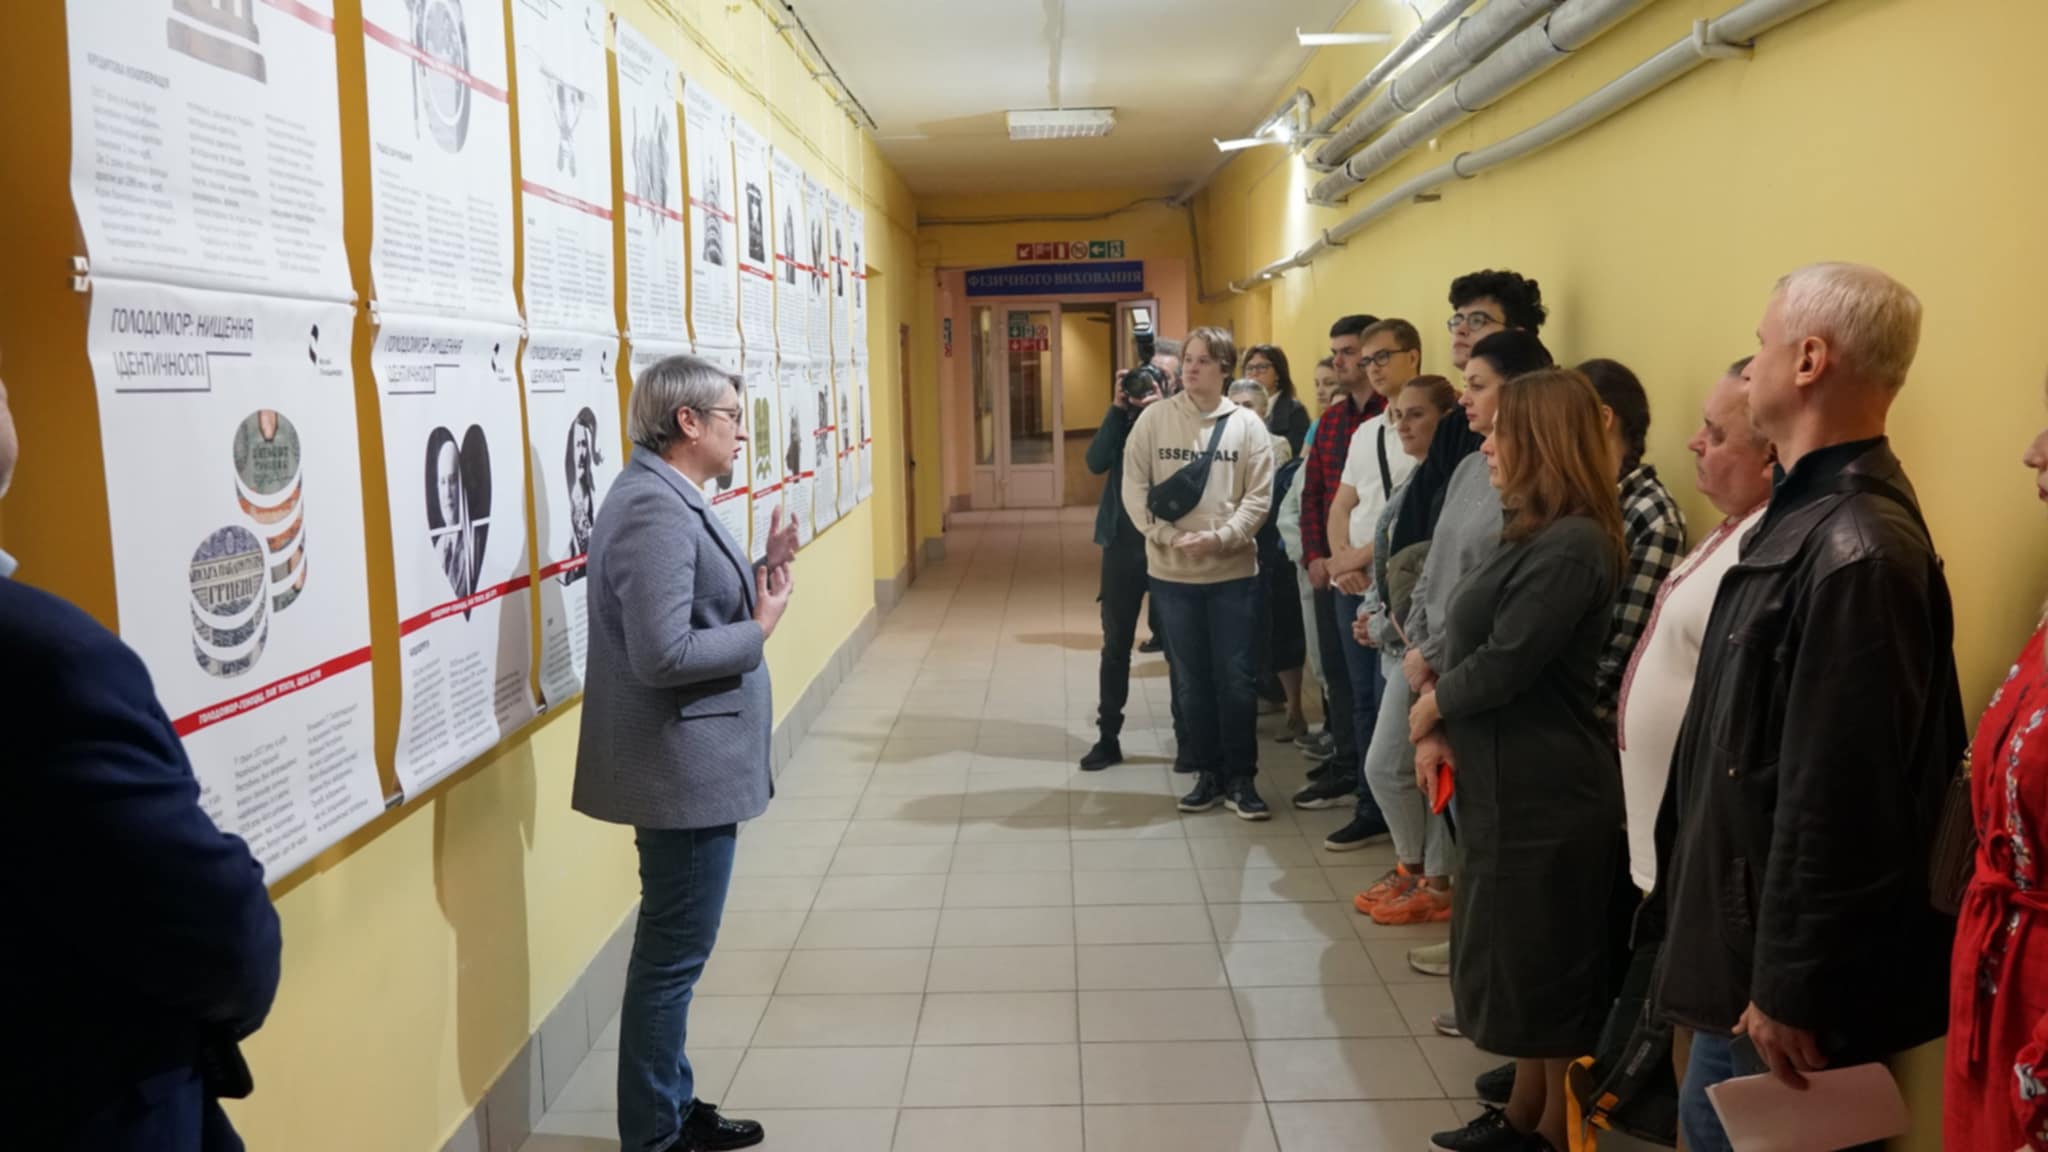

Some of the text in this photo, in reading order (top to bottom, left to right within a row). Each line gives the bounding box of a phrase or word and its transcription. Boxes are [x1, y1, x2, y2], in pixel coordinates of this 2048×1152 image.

[968, 271, 1142, 288] ФІЗИЧНОГО ВИХОВАННЯ
[111, 308, 254, 342] ГОЛОДОМОР: НИЩЕННЯ
[113, 351, 205, 380] ІДЕНТИЧНОСТІ
